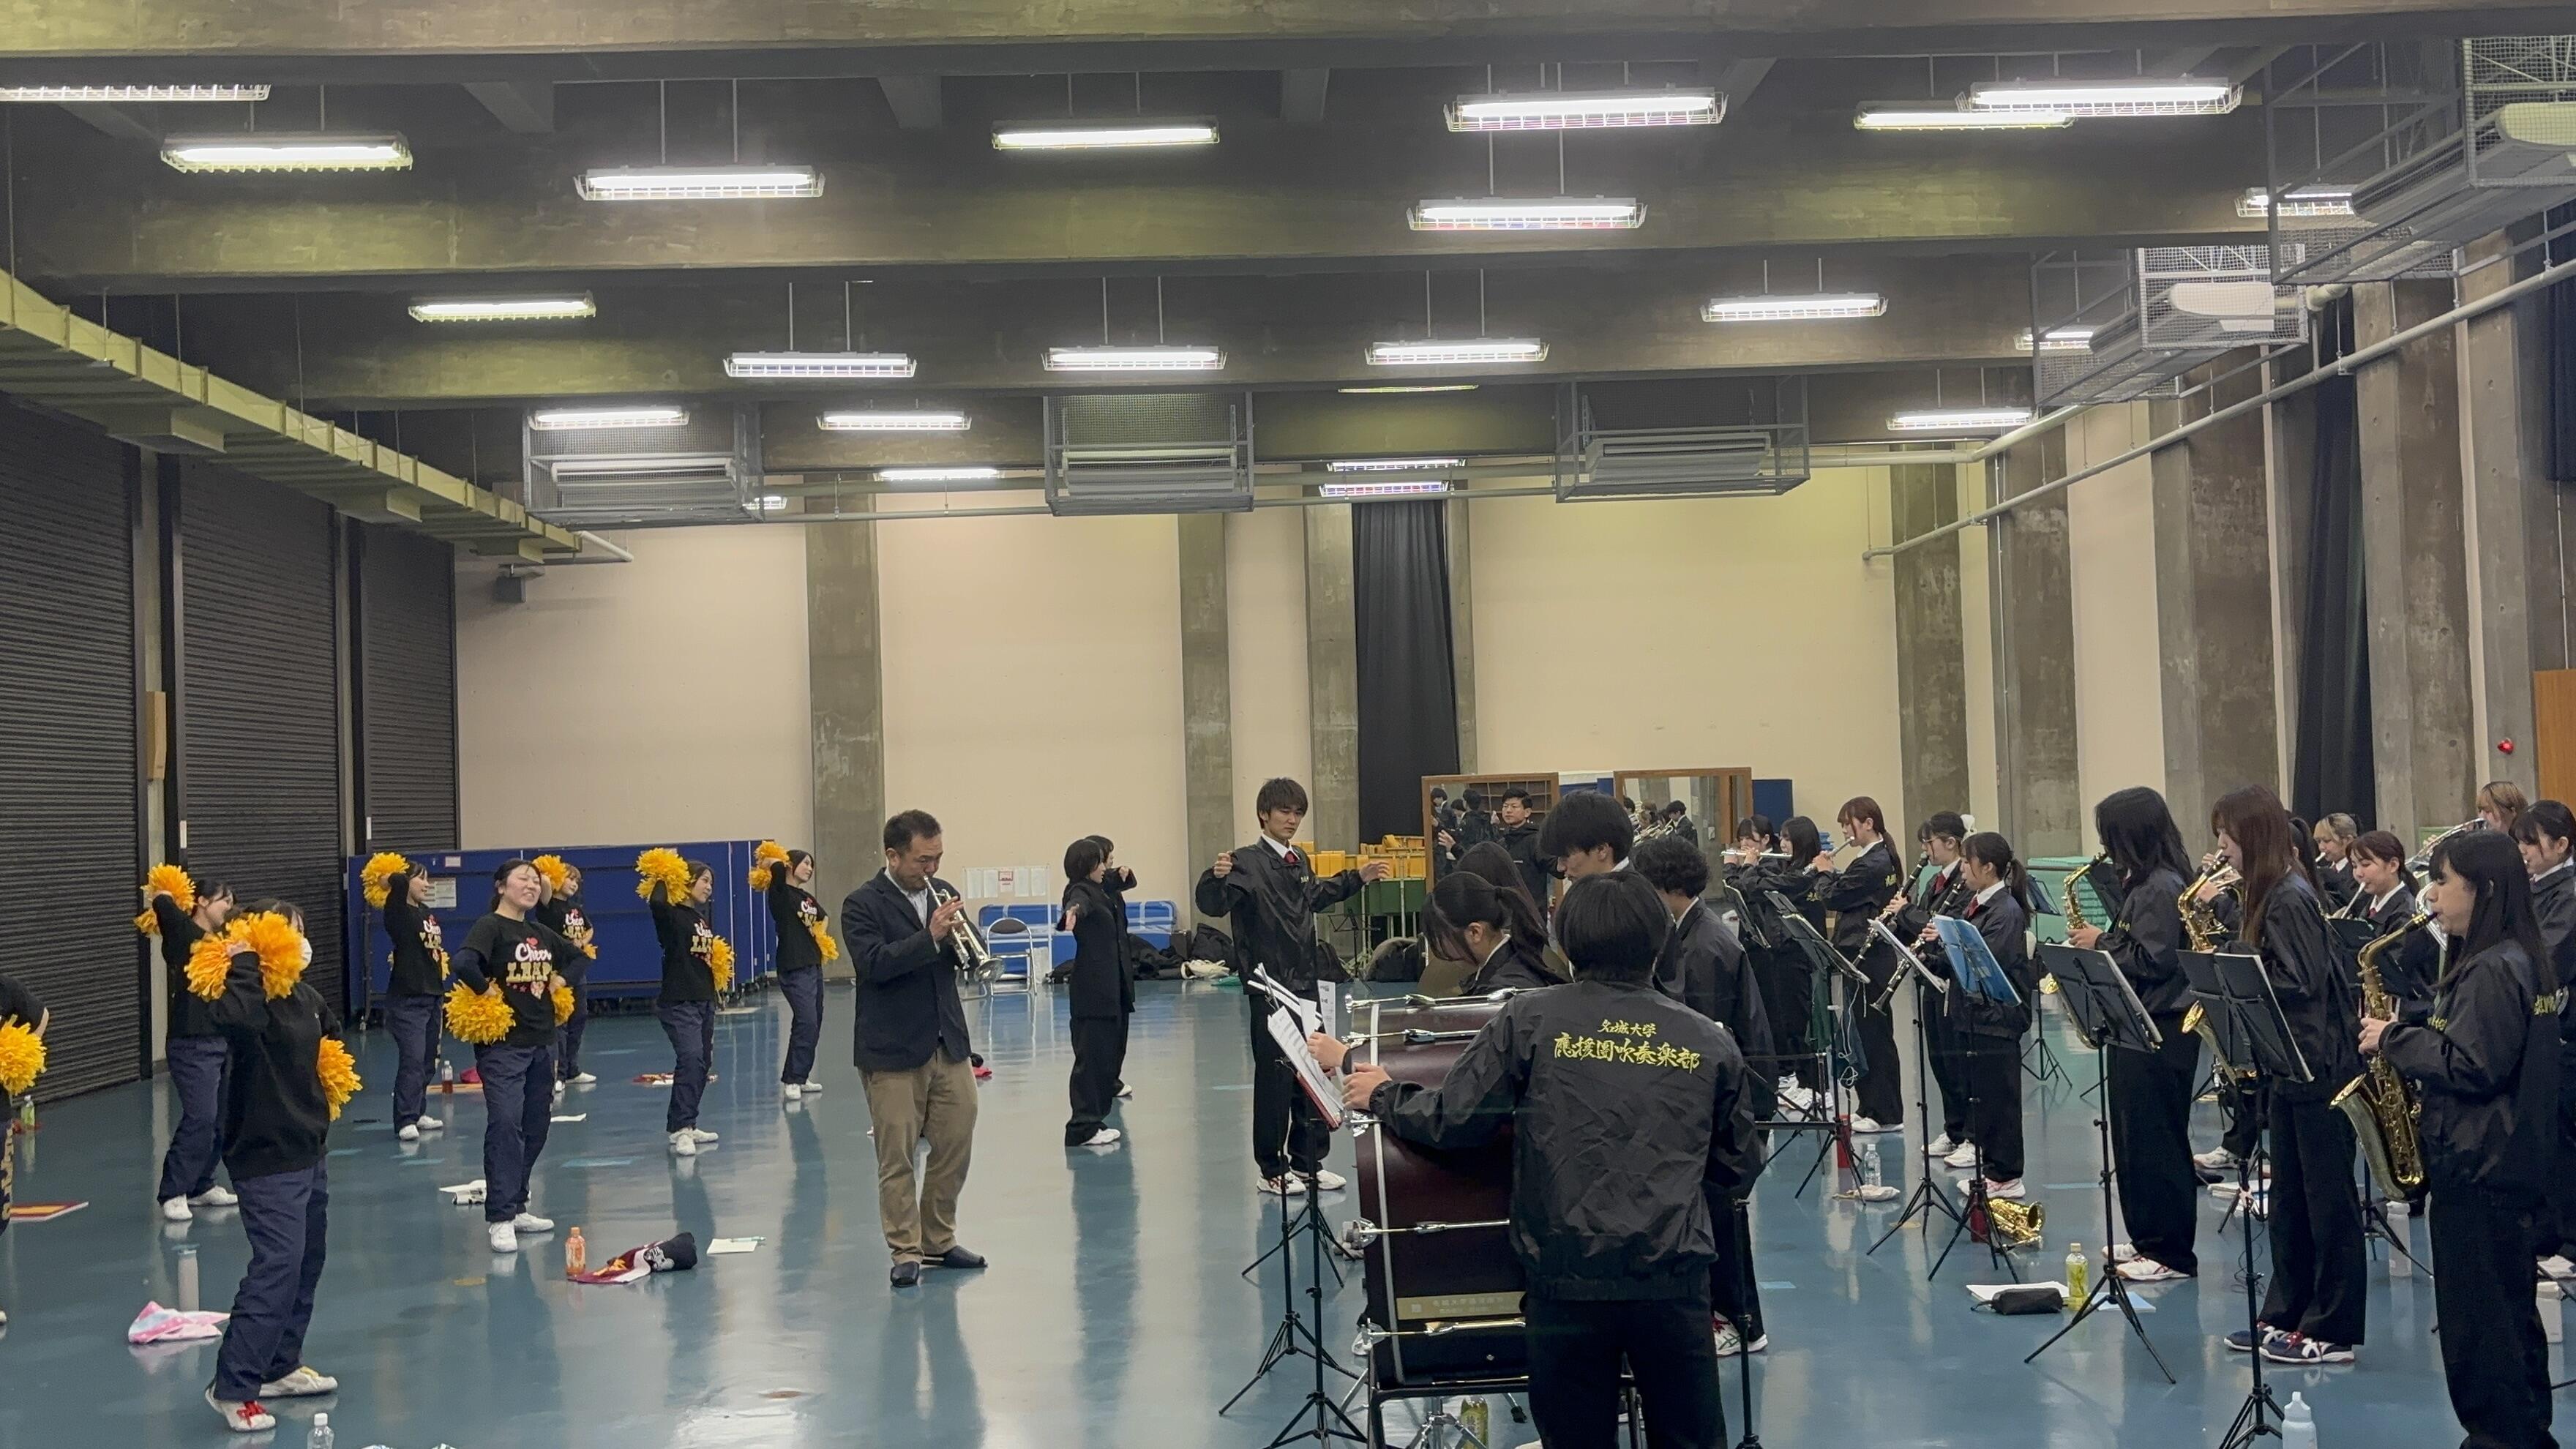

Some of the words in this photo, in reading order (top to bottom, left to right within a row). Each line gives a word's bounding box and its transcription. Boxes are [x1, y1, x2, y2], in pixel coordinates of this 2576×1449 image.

[514, 942, 552, 962] Cheer
[1597, 1019, 1657, 1038] 名城大学
